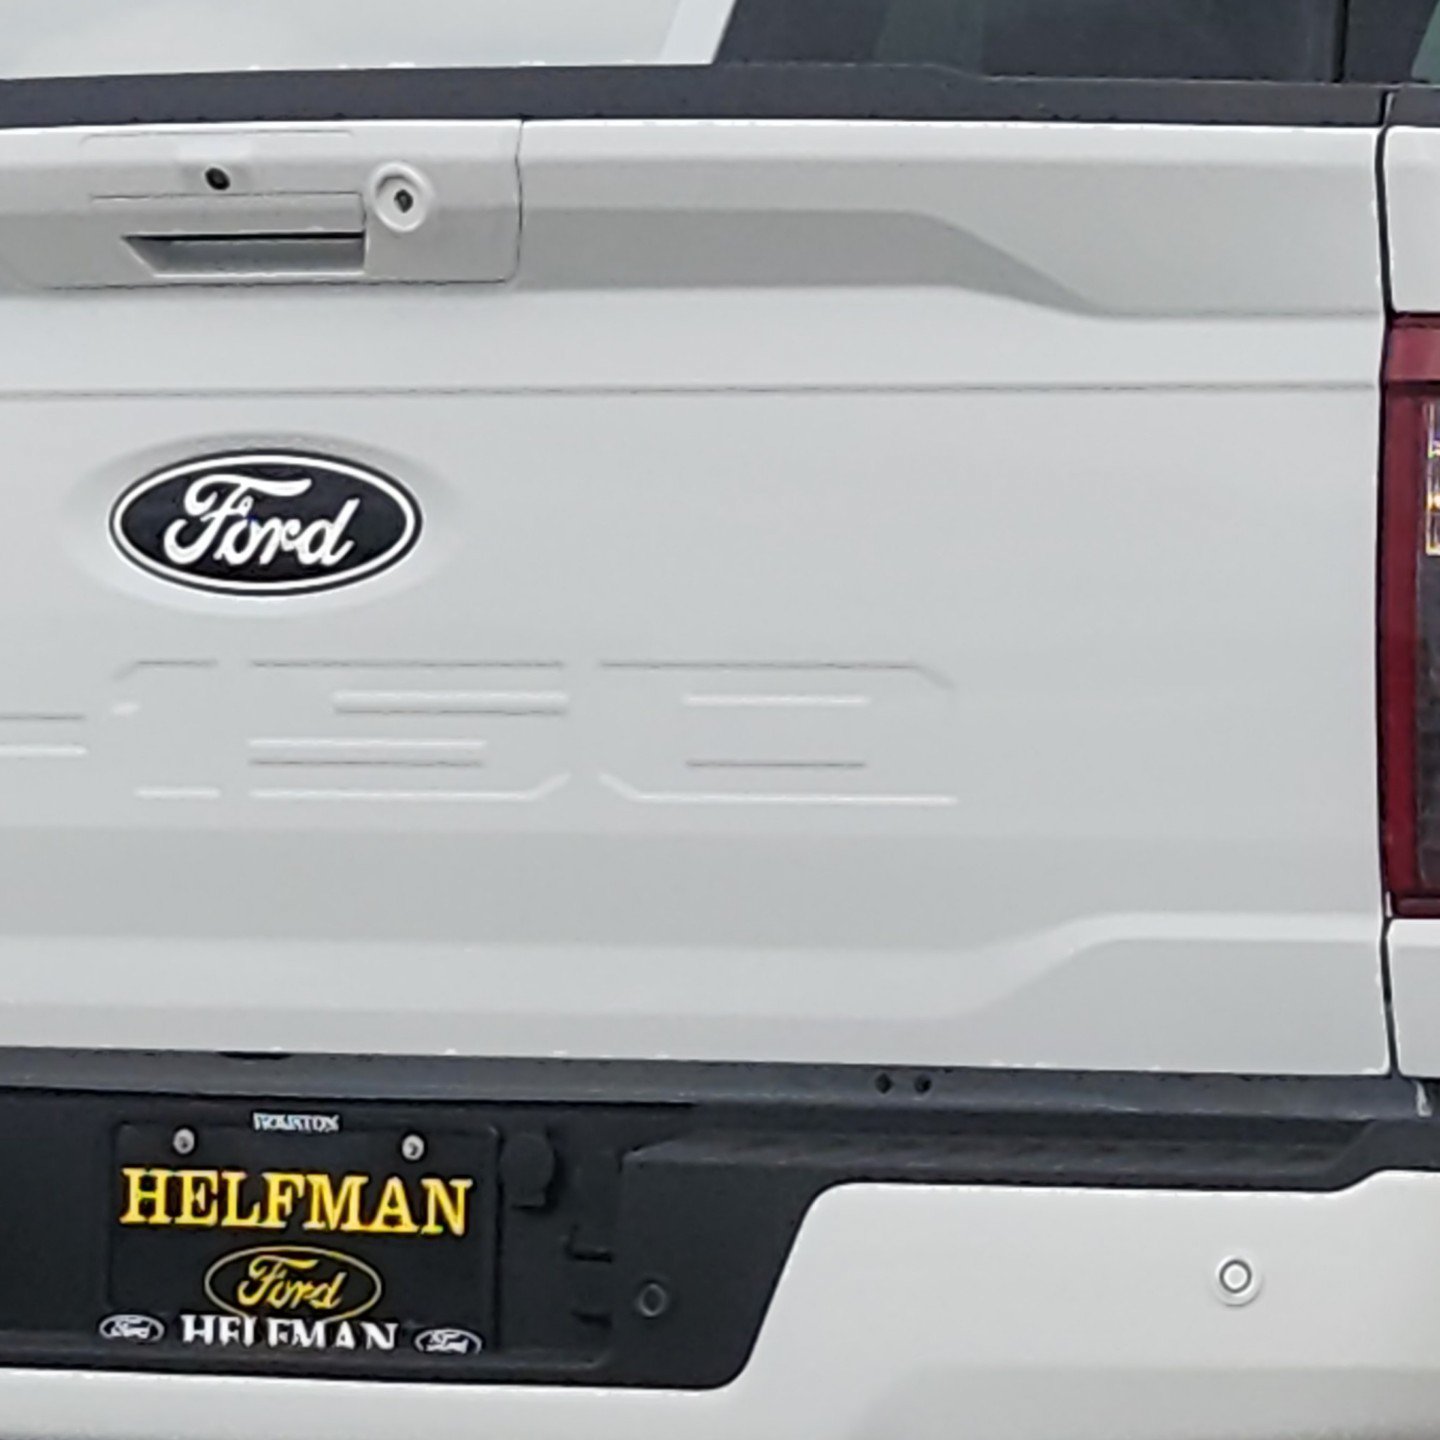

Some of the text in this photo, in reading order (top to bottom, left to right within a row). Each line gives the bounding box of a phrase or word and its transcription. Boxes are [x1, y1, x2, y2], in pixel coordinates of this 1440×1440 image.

[163, 473, 361, 566] Ford
[118, 1167, 473, 1236] HELFMAN
[237, 1254, 347, 1310] Ford
